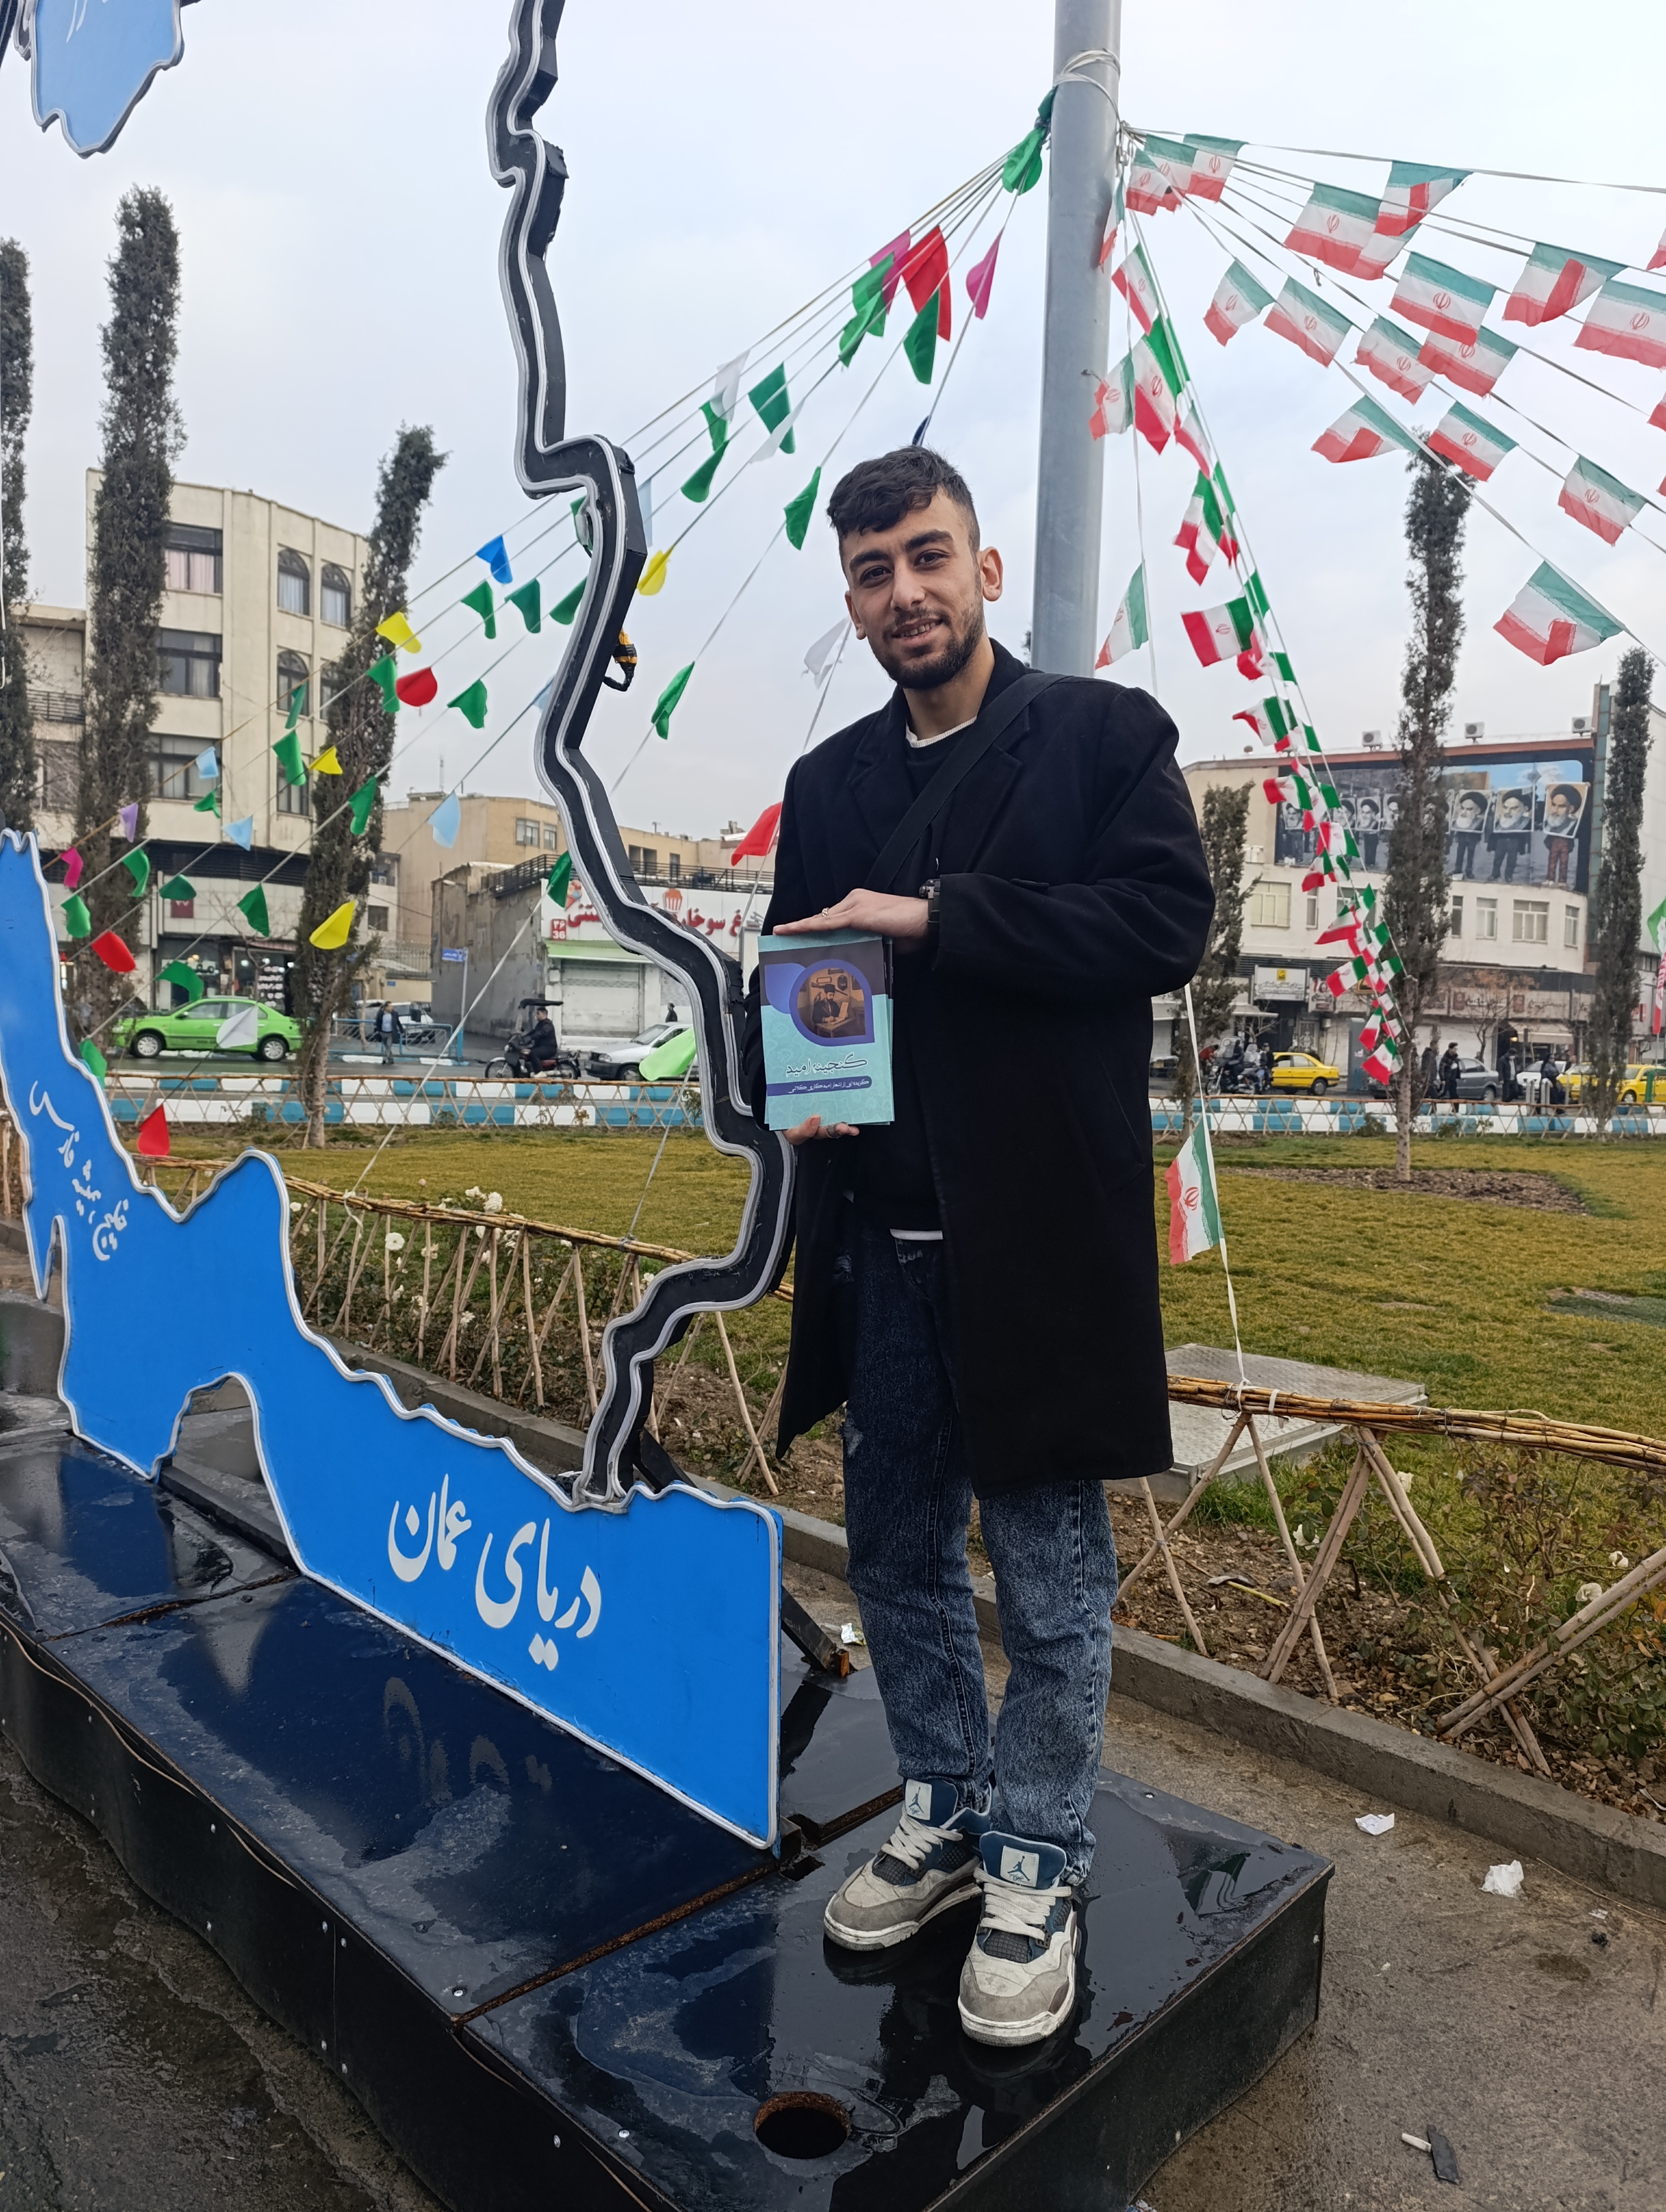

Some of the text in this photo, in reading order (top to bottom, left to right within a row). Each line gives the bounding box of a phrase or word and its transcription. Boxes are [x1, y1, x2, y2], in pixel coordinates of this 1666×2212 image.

[553, 930, 566, 940] 36
[786, 1058, 811, 1076] امید
[29, 1080, 80, 1168] فارس
[93, 1198, 129, 1261] خلیج
[388, 1473, 601, 1671] دریای عمان
